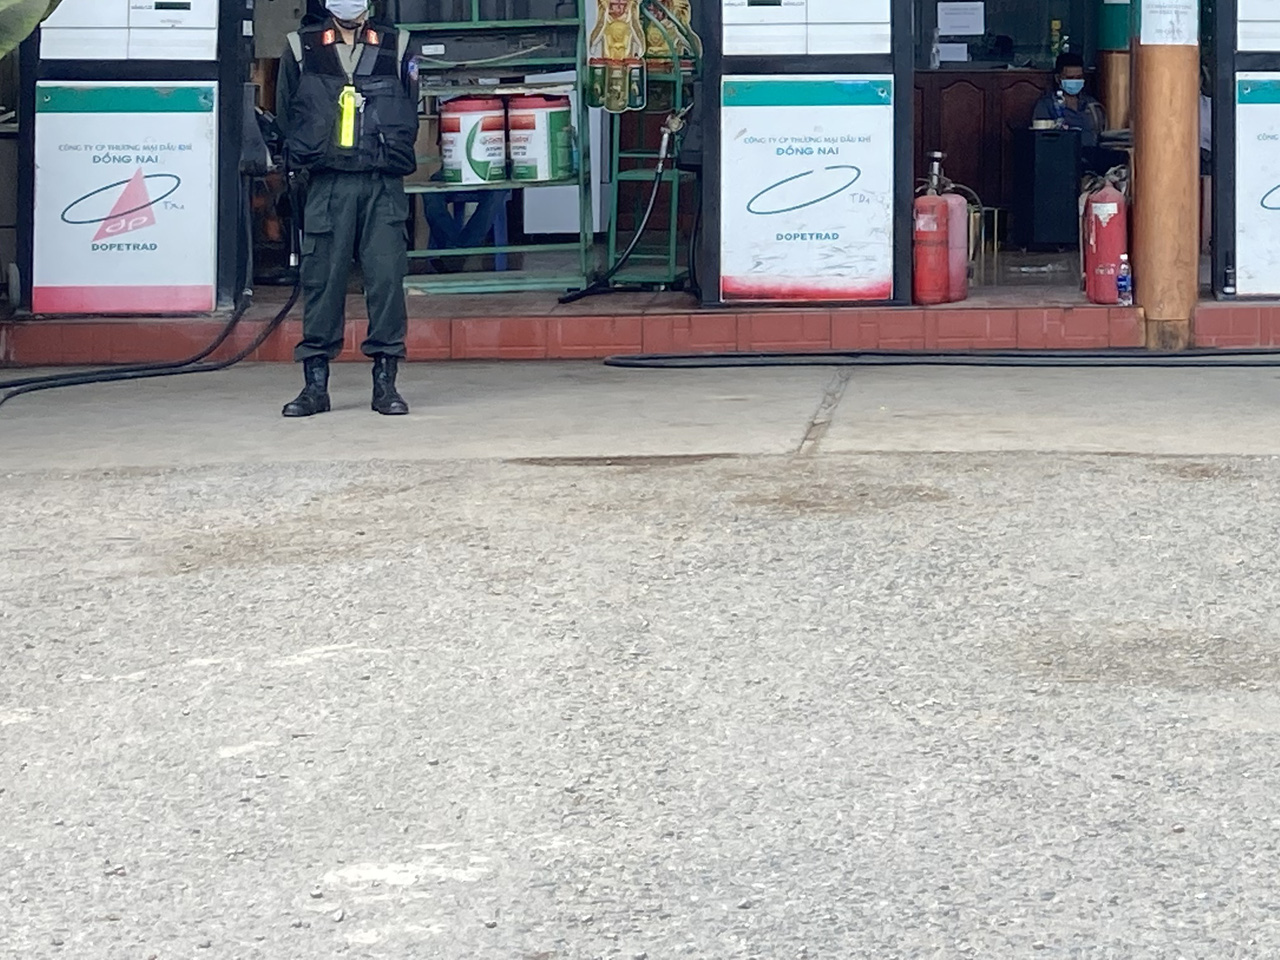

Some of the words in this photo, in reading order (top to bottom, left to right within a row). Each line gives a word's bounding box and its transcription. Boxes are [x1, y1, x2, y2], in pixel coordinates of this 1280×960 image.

[817, 146, 839, 155] NAI
[136, 154, 158, 164] NAI
[776, 232, 839, 241] DOPETRAD
[91, 243, 158, 251] DOPETRAD
